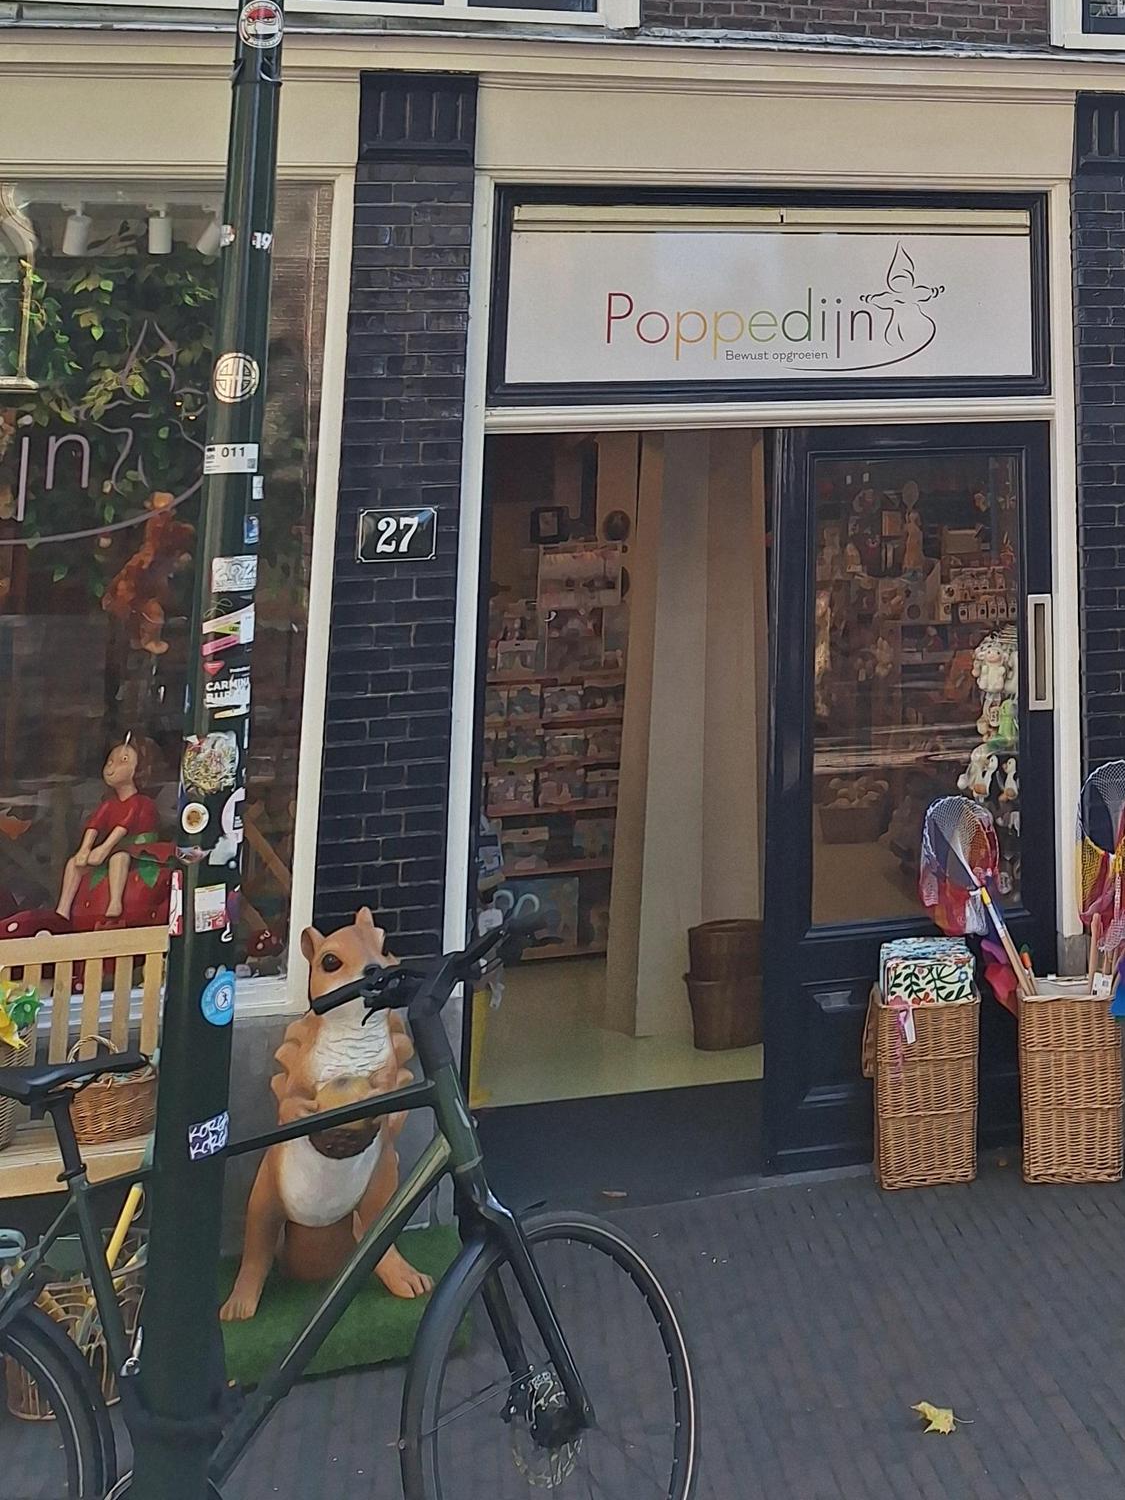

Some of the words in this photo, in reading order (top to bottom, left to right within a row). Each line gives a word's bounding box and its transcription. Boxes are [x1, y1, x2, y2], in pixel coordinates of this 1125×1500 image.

[606, 287, 873, 361] Poppedijn
[725, 350, 769, 361] Bewust
[772, 351, 828, 363] opgroeien
[221, 446, 245, 458] 011
[375, 516, 420, 553] 27
